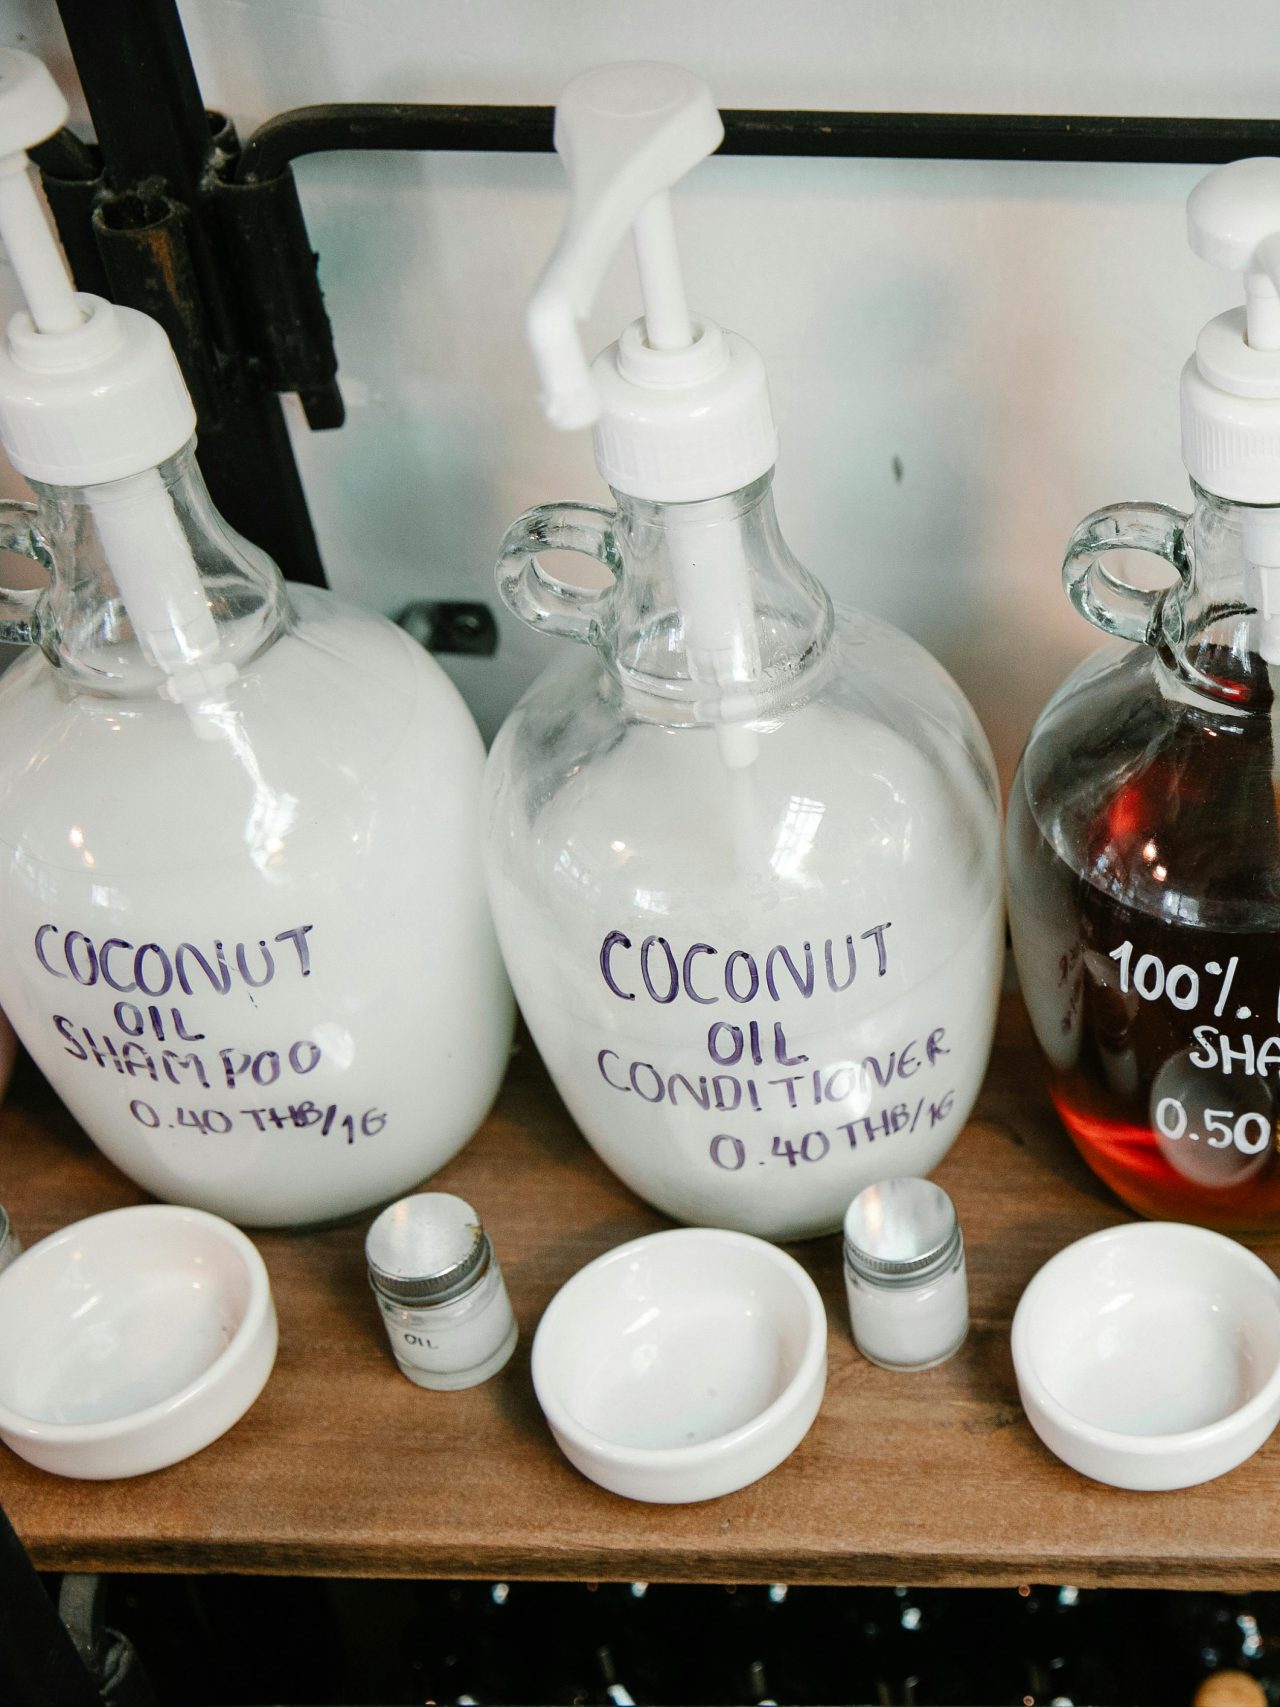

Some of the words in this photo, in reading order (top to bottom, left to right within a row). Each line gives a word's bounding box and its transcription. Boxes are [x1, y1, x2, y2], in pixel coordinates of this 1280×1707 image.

[35, 924, 314, 997] COCONUT
[600, 921, 893, 1004] COCONUT
[114, 1001, 206, 1041] OIL
[707, 1020, 810, 1066] OIL
[53, 1015, 322, 1089] SHAMPOO
[597, 1027, 951, 1112] CONDITIONER
[130, 1099, 233, 1136] 0.40
[1155, 1097, 1272, 1155] 0.50
[709, 1130, 831, 1171] 0.40
[404, 1333, 440, 1350] OIL
